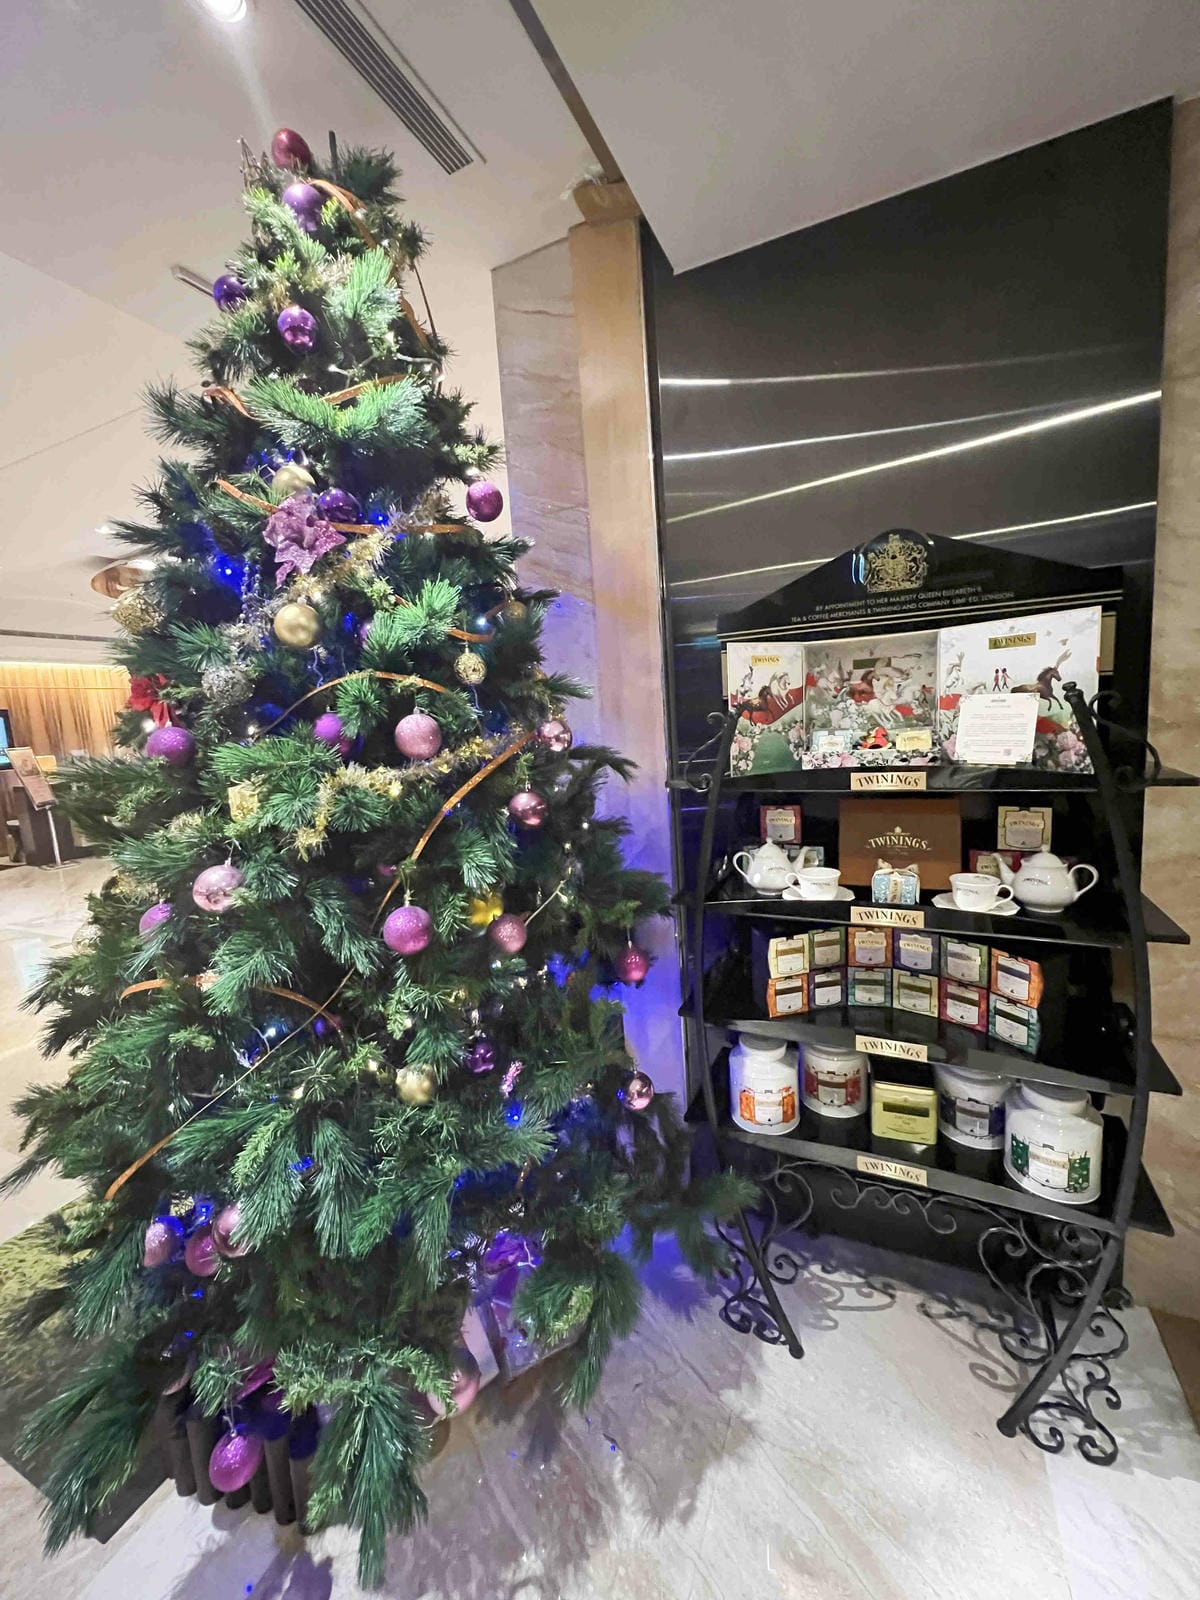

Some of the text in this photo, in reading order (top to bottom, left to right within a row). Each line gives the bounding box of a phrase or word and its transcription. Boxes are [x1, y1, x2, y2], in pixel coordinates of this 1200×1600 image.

[867, 598, 876, 606] TO
[876, 597, 888, 605] HER
[917, 591, 941, 600] QUEEN
[902, 602, 917, 610] AND
[856, 773, 920, 788] TWININGS
[868, 835, 929, 850] TWININGS
[856, 909, 919, 926] TWININGS
[861, 1041, 922, 1059] TWININGS
[864, 1160, 921, 1182] TWININGS
